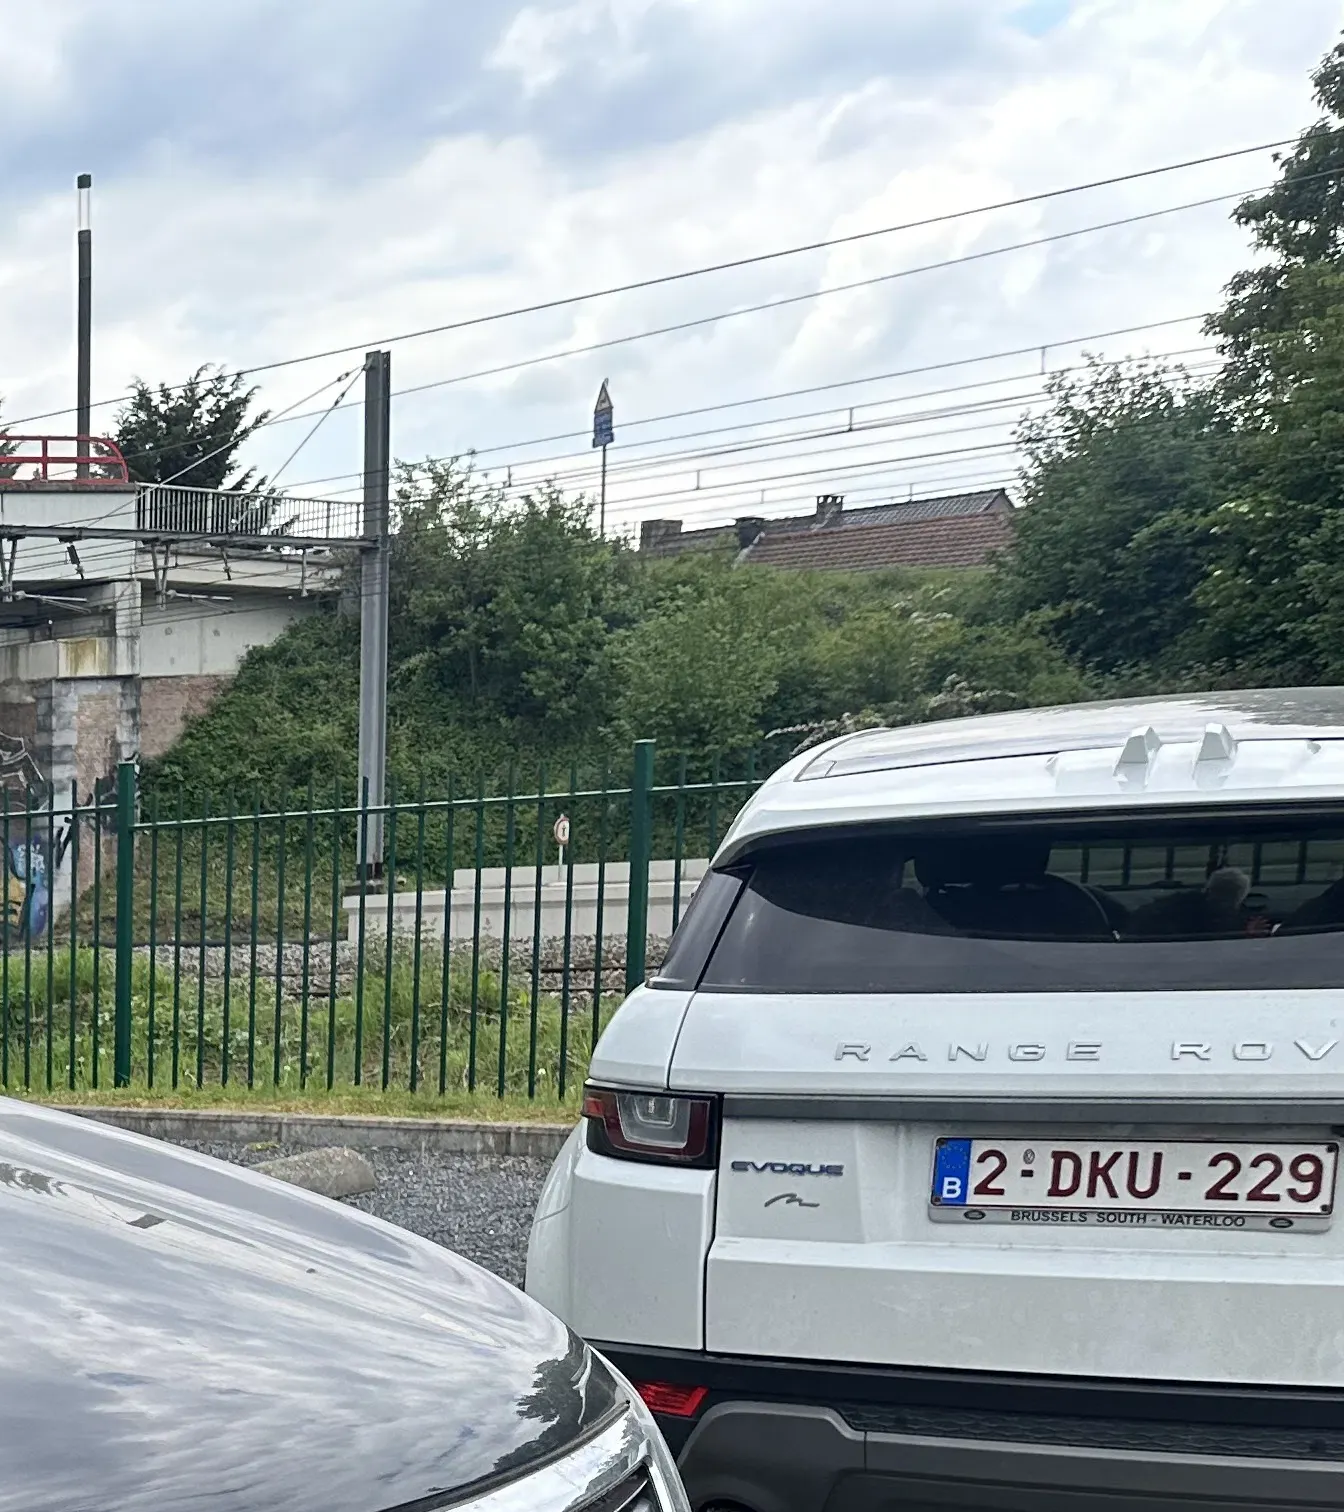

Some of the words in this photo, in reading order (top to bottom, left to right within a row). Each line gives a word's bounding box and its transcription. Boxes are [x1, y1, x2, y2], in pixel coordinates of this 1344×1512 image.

[833, 1039, 1103, 1062] RANGE
[731, 1161, 844, 1176] EVOQUE
[942, 1176, 962, 1199] B
[1011, 1209, 1088, 1223] BRUSSELS
[1096, 1212, 1147, 1225] SOUTH
[1161, 1214, 1246, 1227] WATERLOO
